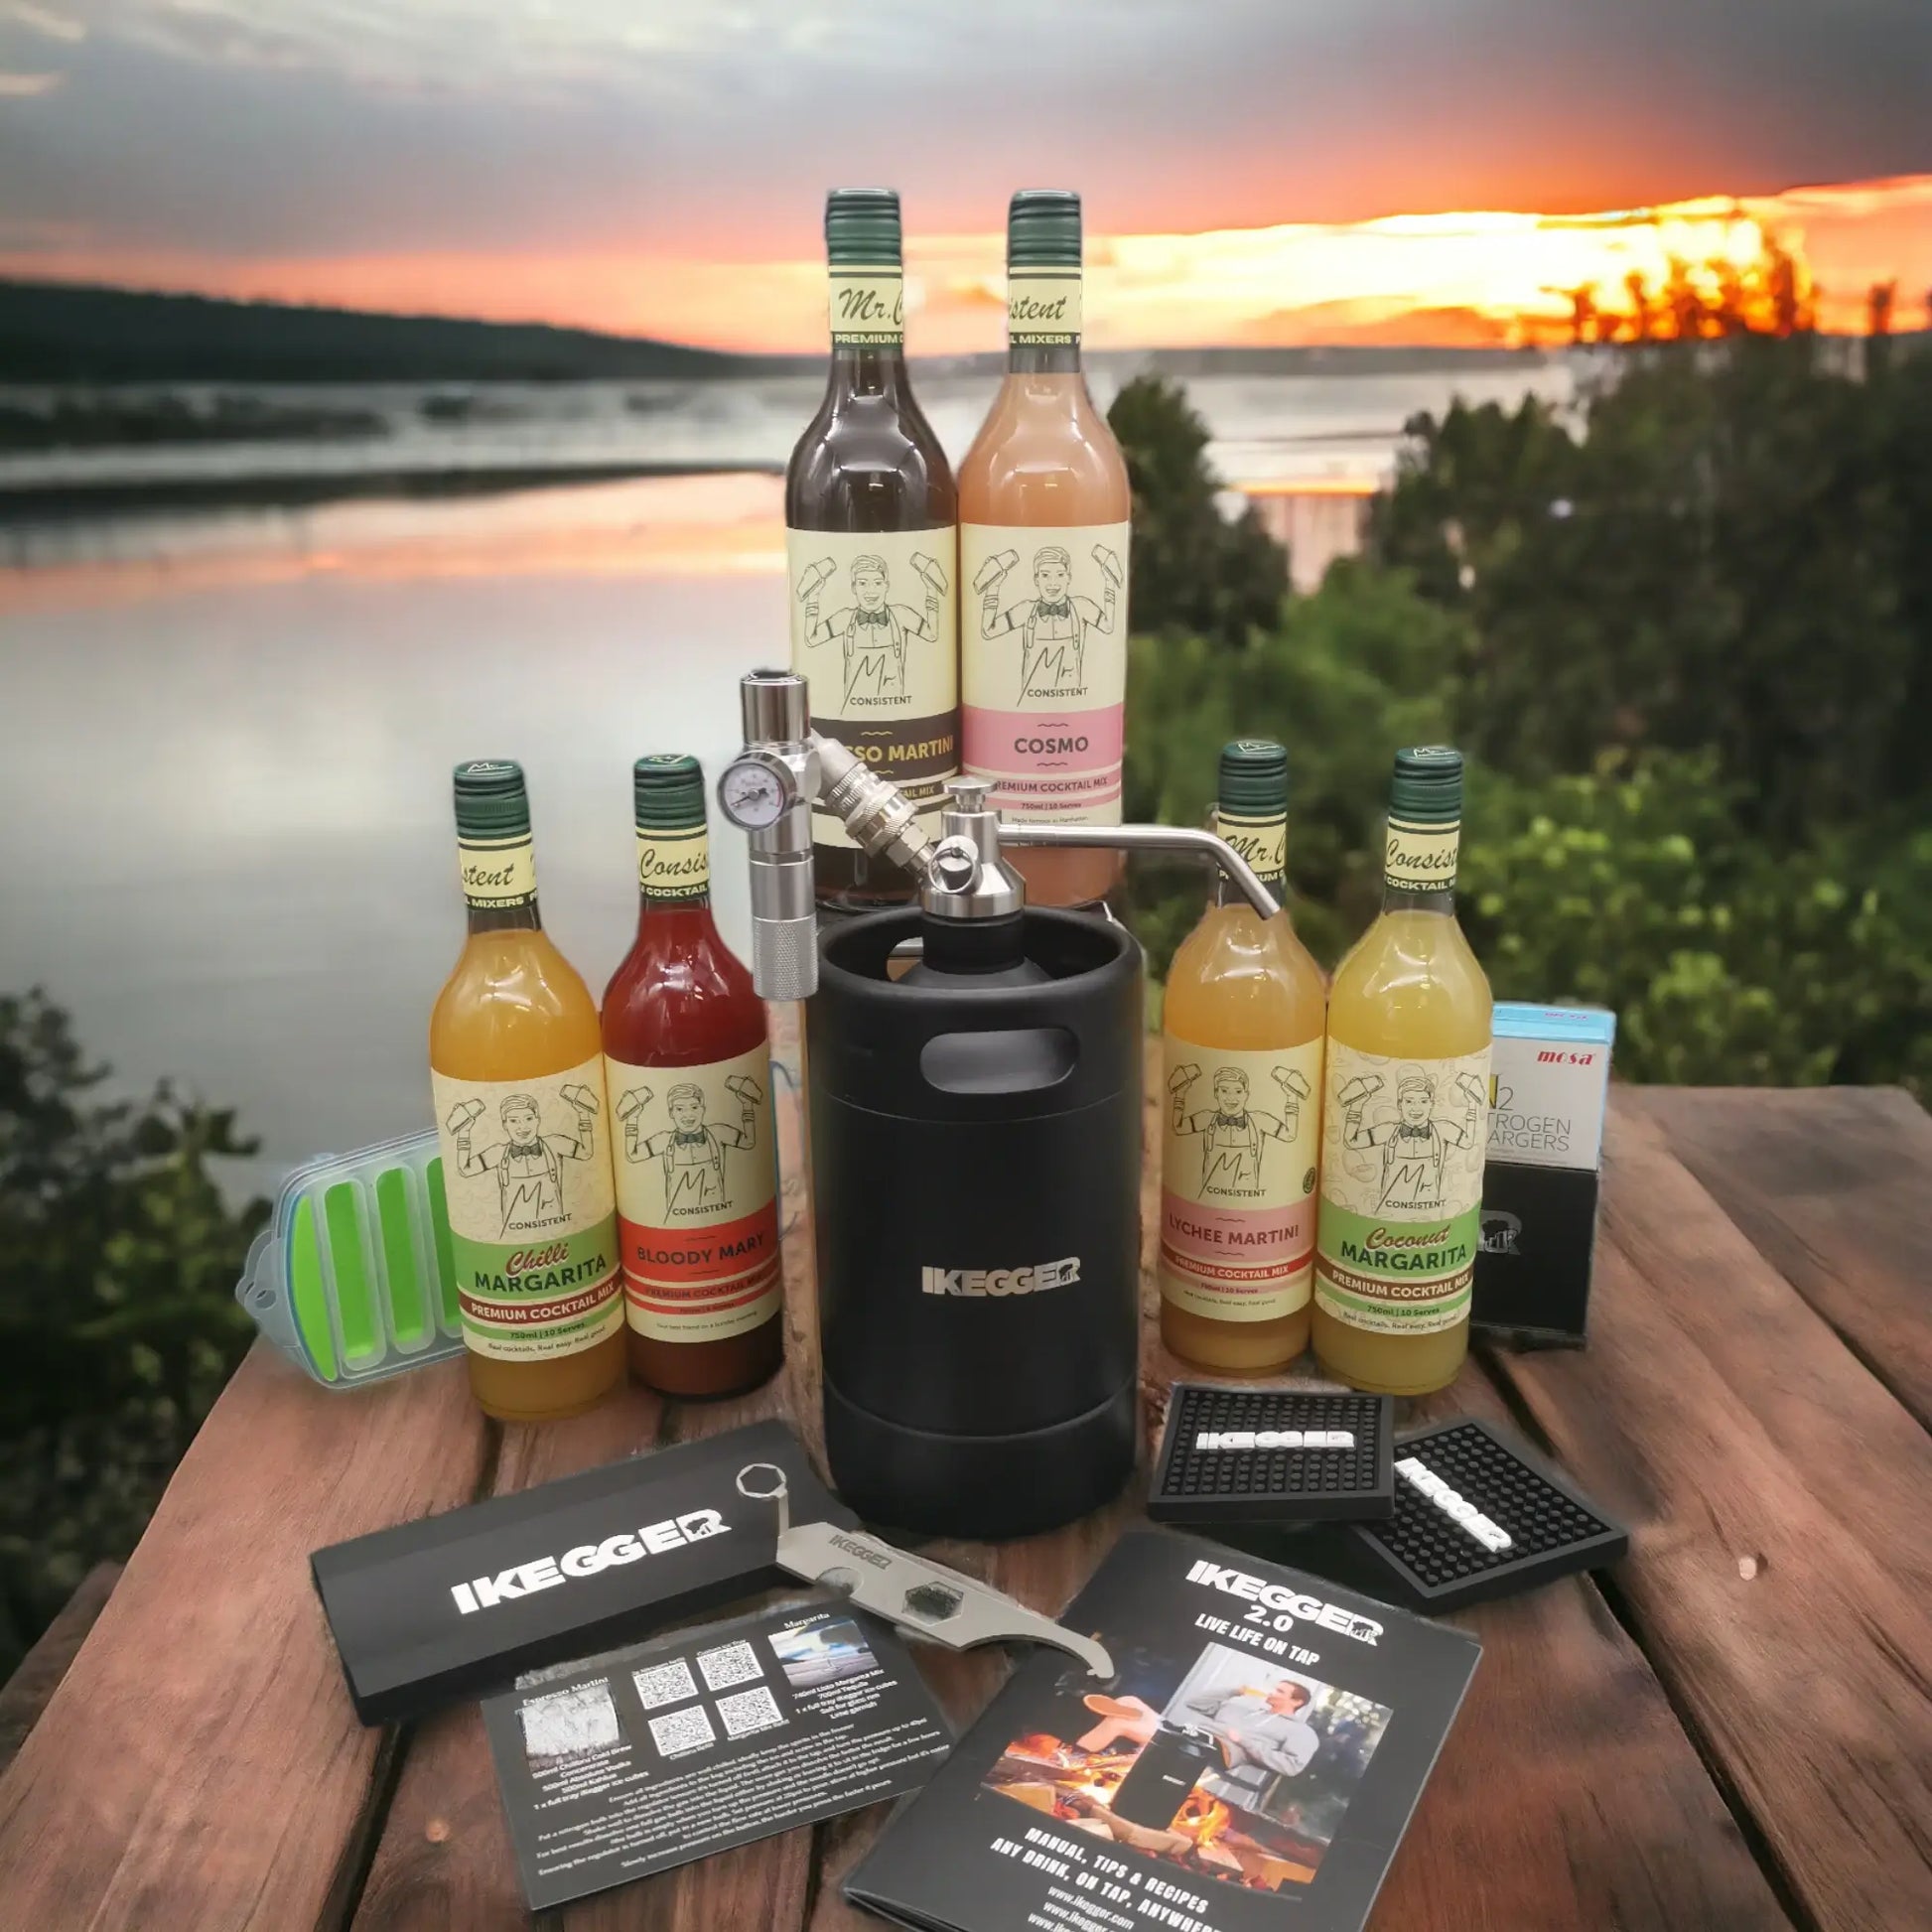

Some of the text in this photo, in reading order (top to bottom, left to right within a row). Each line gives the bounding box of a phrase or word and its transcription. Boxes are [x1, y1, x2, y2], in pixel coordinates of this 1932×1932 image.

[839, 288, 891, 321] Mr.
[835, 334, 897, 344] PREMIUM
[1019, 335, 1071, 345] MIXERS
[850, 695, 912, 706] CONSISTENT
[1028, 687, 1088, 698] CONSISTENT
[889, 735, 954, 761] MARTINI
[1014, 737, 1089, 755] COSMO
[919, 784, 935, 795] MIX
[1040, 780, 1092, 792] COCKTAIL
[1093, 776, 1108, 787] MIX
[646, 885, 707, 897] COCKTAIL
[1387, 877, 1448, 891] COCKTAIL
[472, 897, 524, 908] MIXERS
[1206, 1185, 1267, 1197] CONSISTENT
[1385, 1199, 1447, 1209] CONSISTENT
[508, 1212, 572, 1230] CONSISTENT
[672, 1200, 734, 1216] CONSISTENT
[1169, 1213, 1299, 1245] LYCHEE MARTINI
[1365, 1223, 1451, 1251] Coconut
[505, 1242, 569, 1278] Chilli
[636, 1233, 764, 1265] BLOODY MARY
[1341, 1240, 1466, 1271] MARGARITA
[475, 1254, 607, 1293] MARGARITA
[921, 1256, 1081, 1297] IKEGGER
[1174, 1255, 1289, 1279] PREMIUM COCKTAIL MIX
[1332, 1270, 1469, 1298] PREMIUM COCKTAIL MIX
[471, 1282, 615, 1320] PREMIUM COCKTAIL MIX
[1367, 1305, 1394, 1316] 750ml
[1413, 1308, 1440, 1316] Serves
[509, 1330, 539, 1340] 750ml
[557, 1322, 585, 1335] Serves
[451, 1508, 732, 1614] IKEGGER
[1185, 1560, 1384, 1646] IKEGGER
[1243, 1604, 1294, 1632] 2.0
[1194, 1613, 1320, 1666] LIVE LIFE ON TAP
[522, 1677, 609, 1707] Espresso Martini
[1025, 1827, 1209, 1914] MANUAL, TIPS & RECIPES
[990, 1838, 1222, 1932] ANY DRINK, ON TAP, ANYWHE
